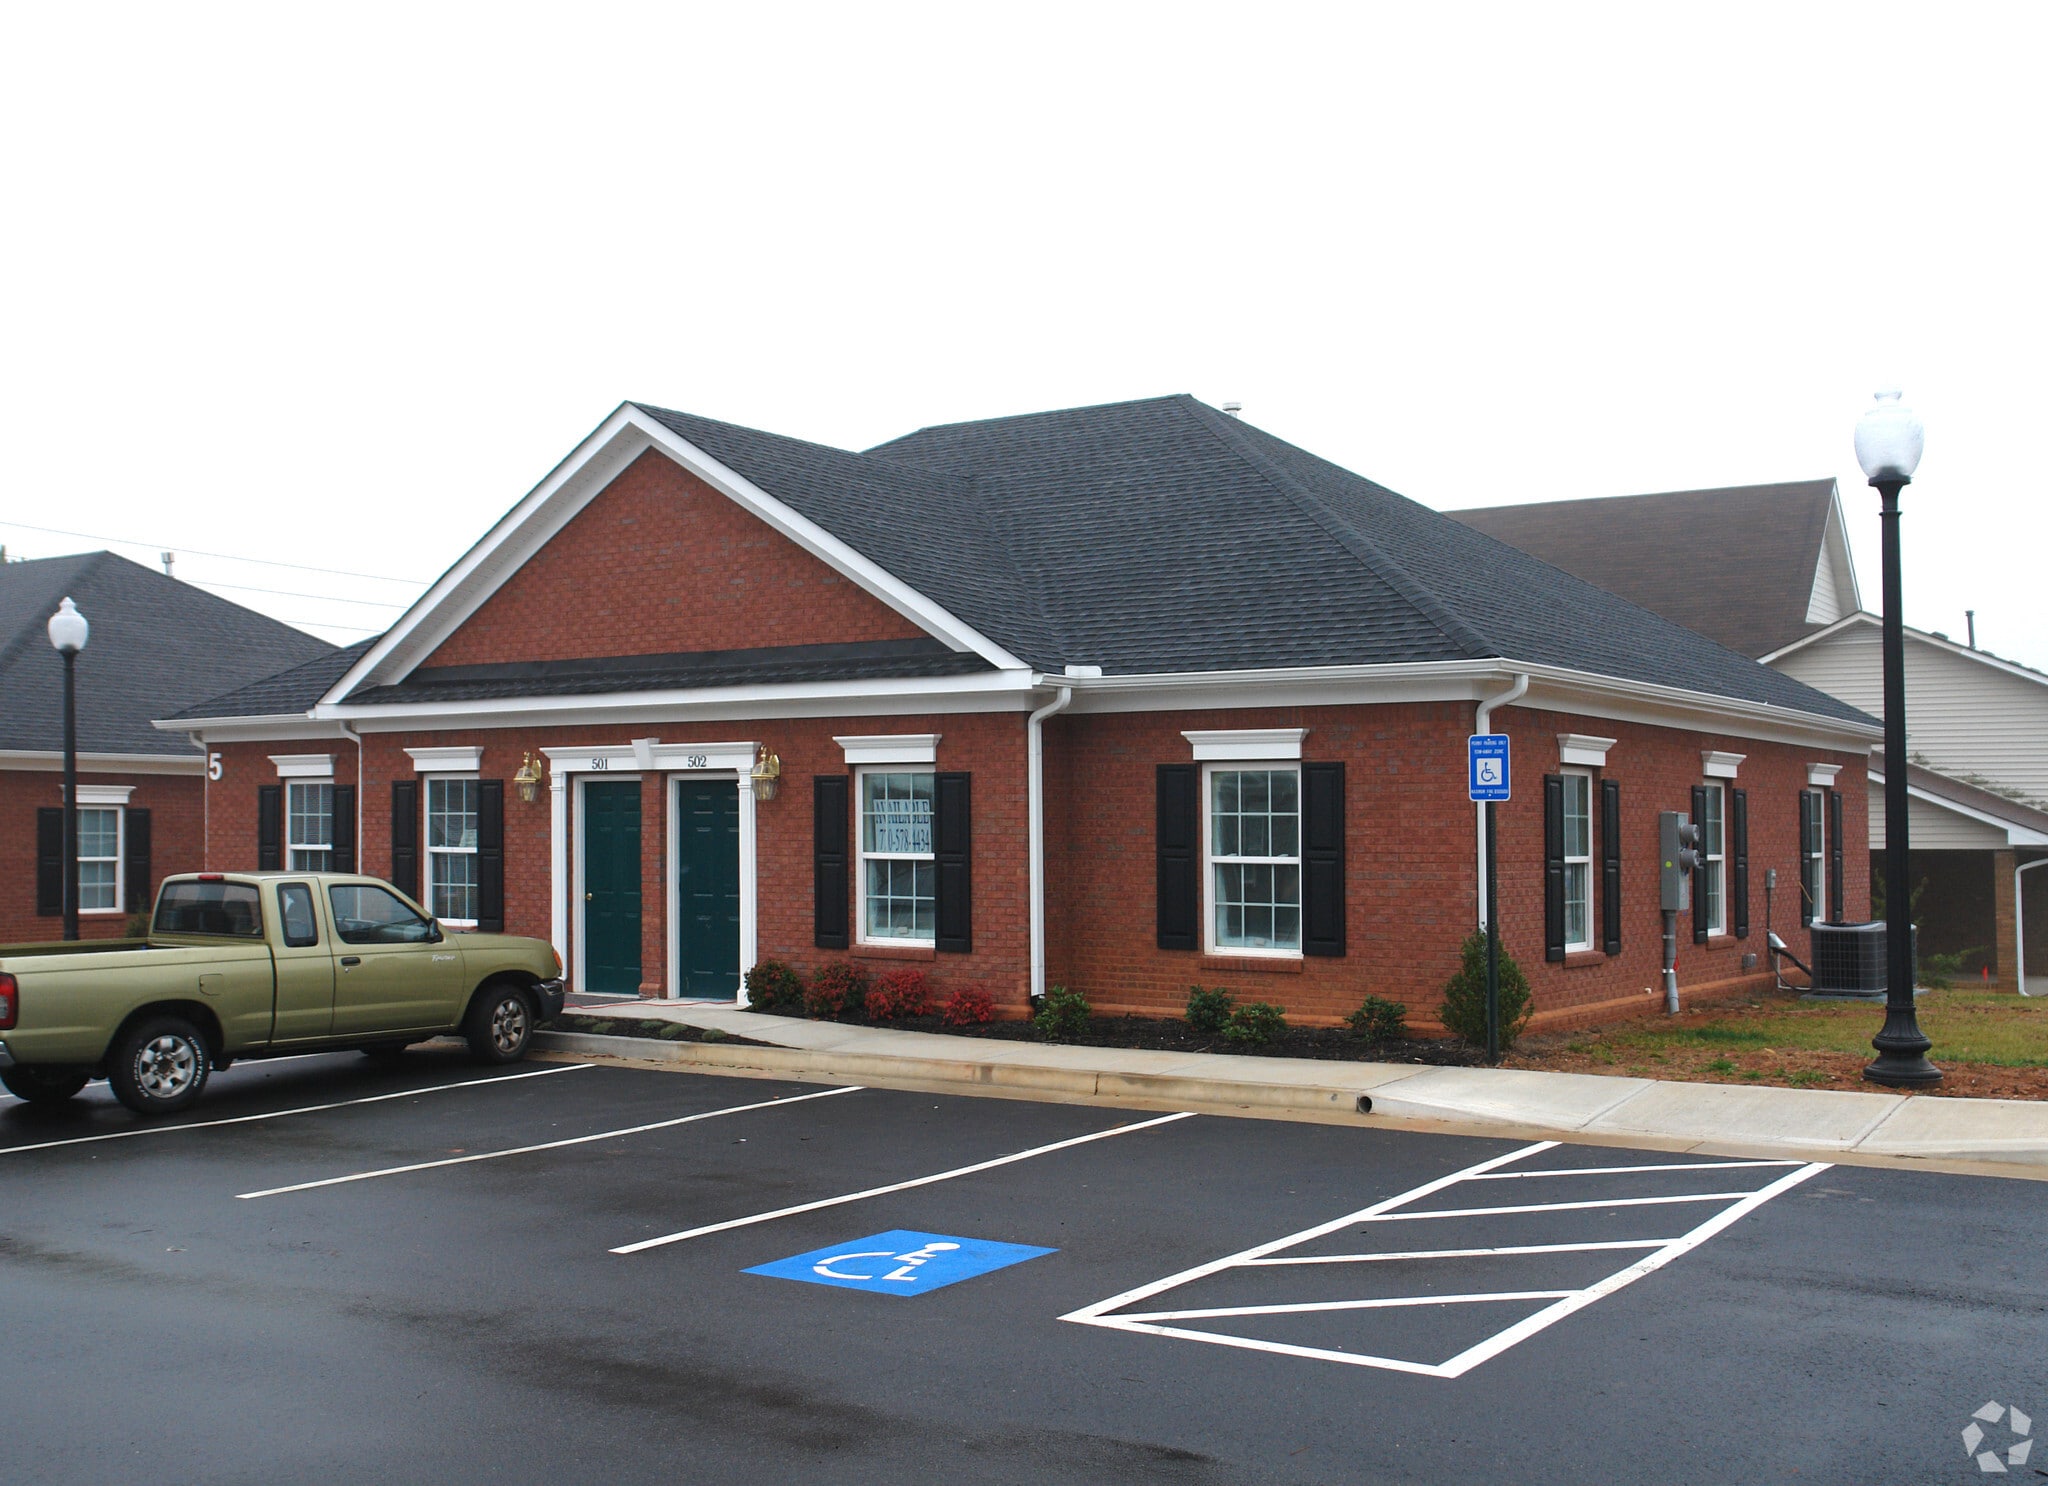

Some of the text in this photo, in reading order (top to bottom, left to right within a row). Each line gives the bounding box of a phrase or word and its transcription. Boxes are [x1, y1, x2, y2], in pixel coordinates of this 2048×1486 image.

[208, 752, 223, 781] 5
[591, 758, 608, 770] 501
[687, 755, 707, 768] 502
